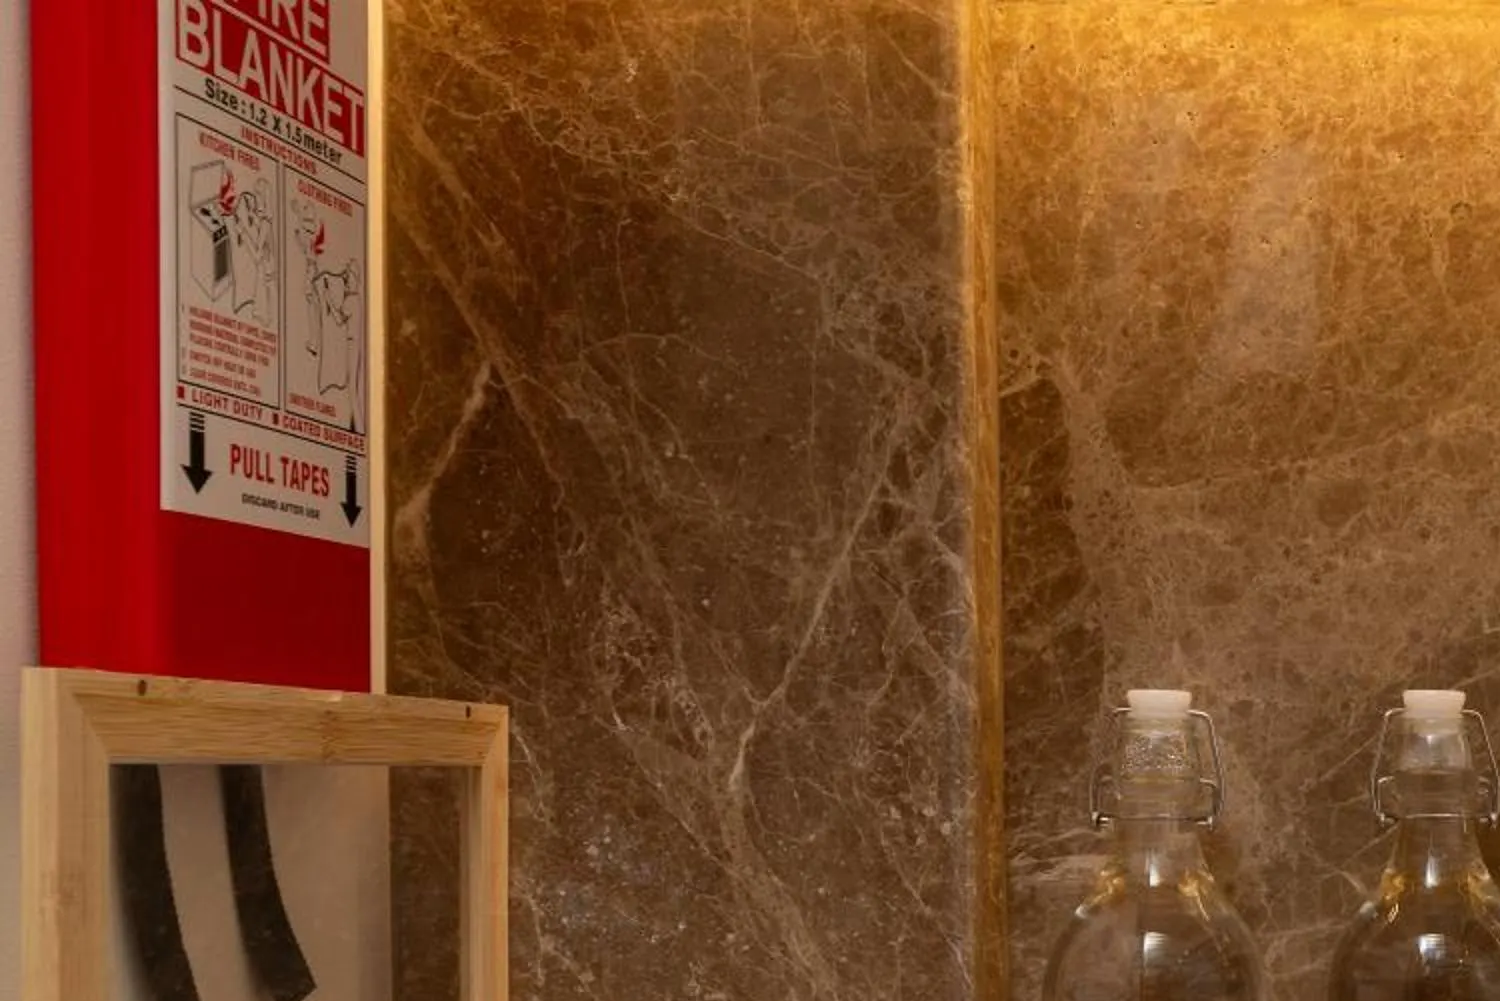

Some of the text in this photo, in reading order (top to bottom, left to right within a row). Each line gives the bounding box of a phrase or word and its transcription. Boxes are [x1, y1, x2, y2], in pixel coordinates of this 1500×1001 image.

[179, 0, 365, 156] BLANKET
[240, 125, 317, 175] INSTRUCTIONS
[192, 388, 229, 415] LIGHT
[233, 402, 263, 421] DUTY
[283, 415, 322, 437] COATED
[324, 428, 365, 451] SURFACE
[229, 443, 330, 498] PULL TAPES
